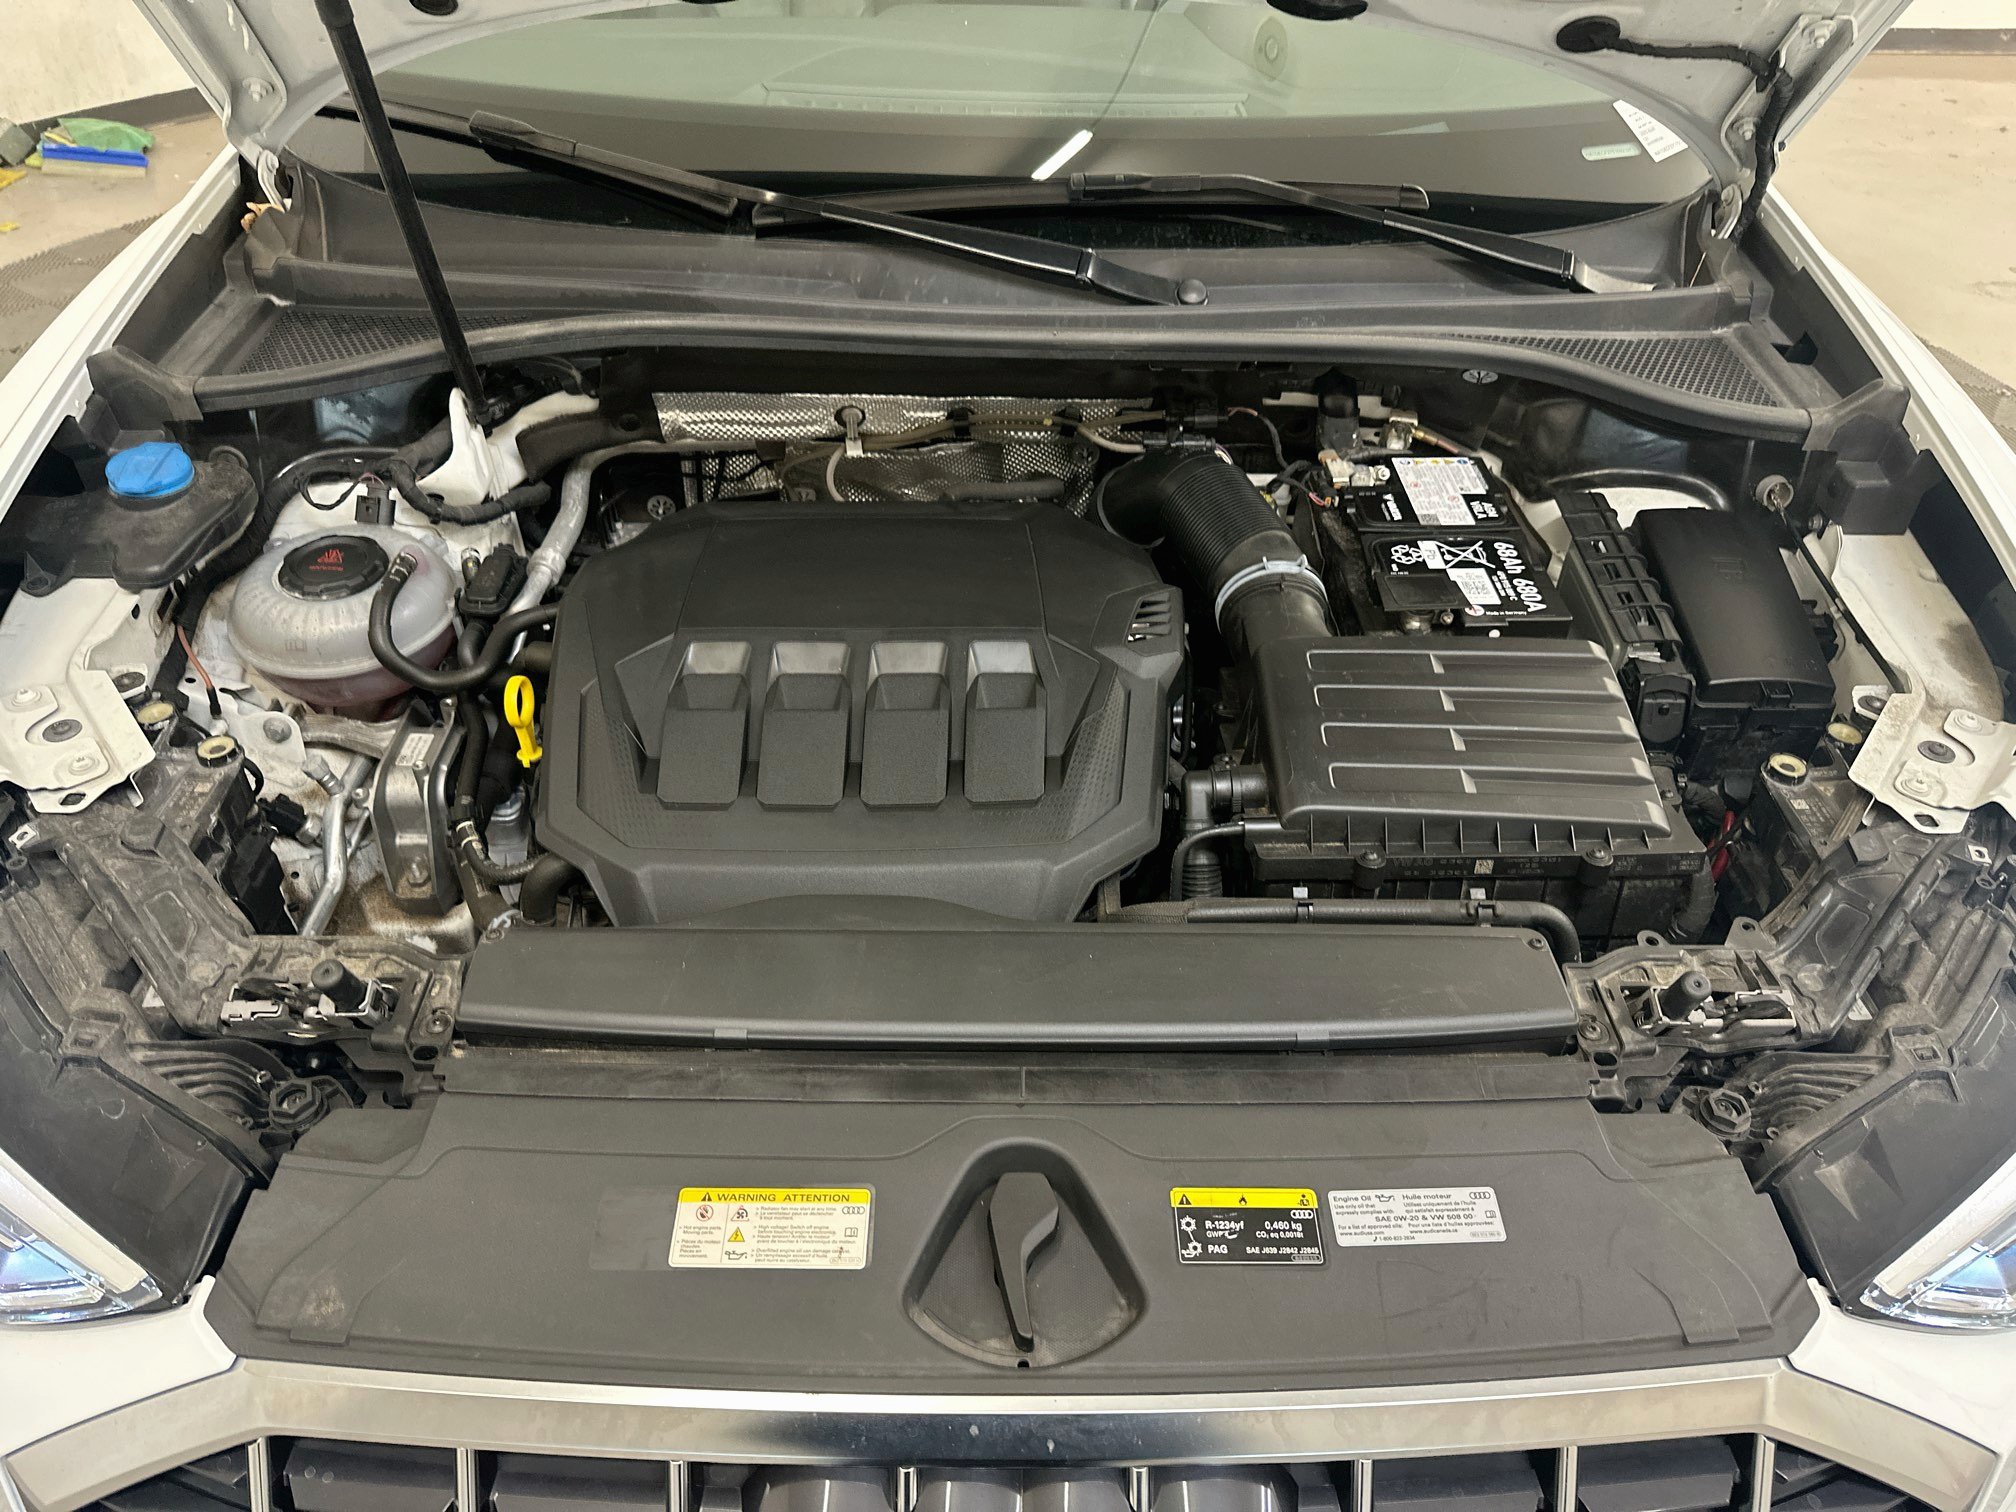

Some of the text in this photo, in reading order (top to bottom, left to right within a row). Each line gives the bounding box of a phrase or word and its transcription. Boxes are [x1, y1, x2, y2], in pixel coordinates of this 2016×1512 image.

[1481, 501, 1499, 518] AGM
[1425, 549, 1437, 561] Pb
[1493, 541, 1526, 575] 68Ah
[1512, 578, 1548, 613] 680A
[717, 1193, 850, 1203] WARNING ATTENTION
[1333, 1195, 1359, 1203] Engine
[1205, 1220, 1303, 1232] R-1234yf 0,460 kg
[1207, 1244, 1229, 1254] PAG
[1245, 1246, 1261, 1254] SAE
[1261, 1246, 1278, 1254] J639
